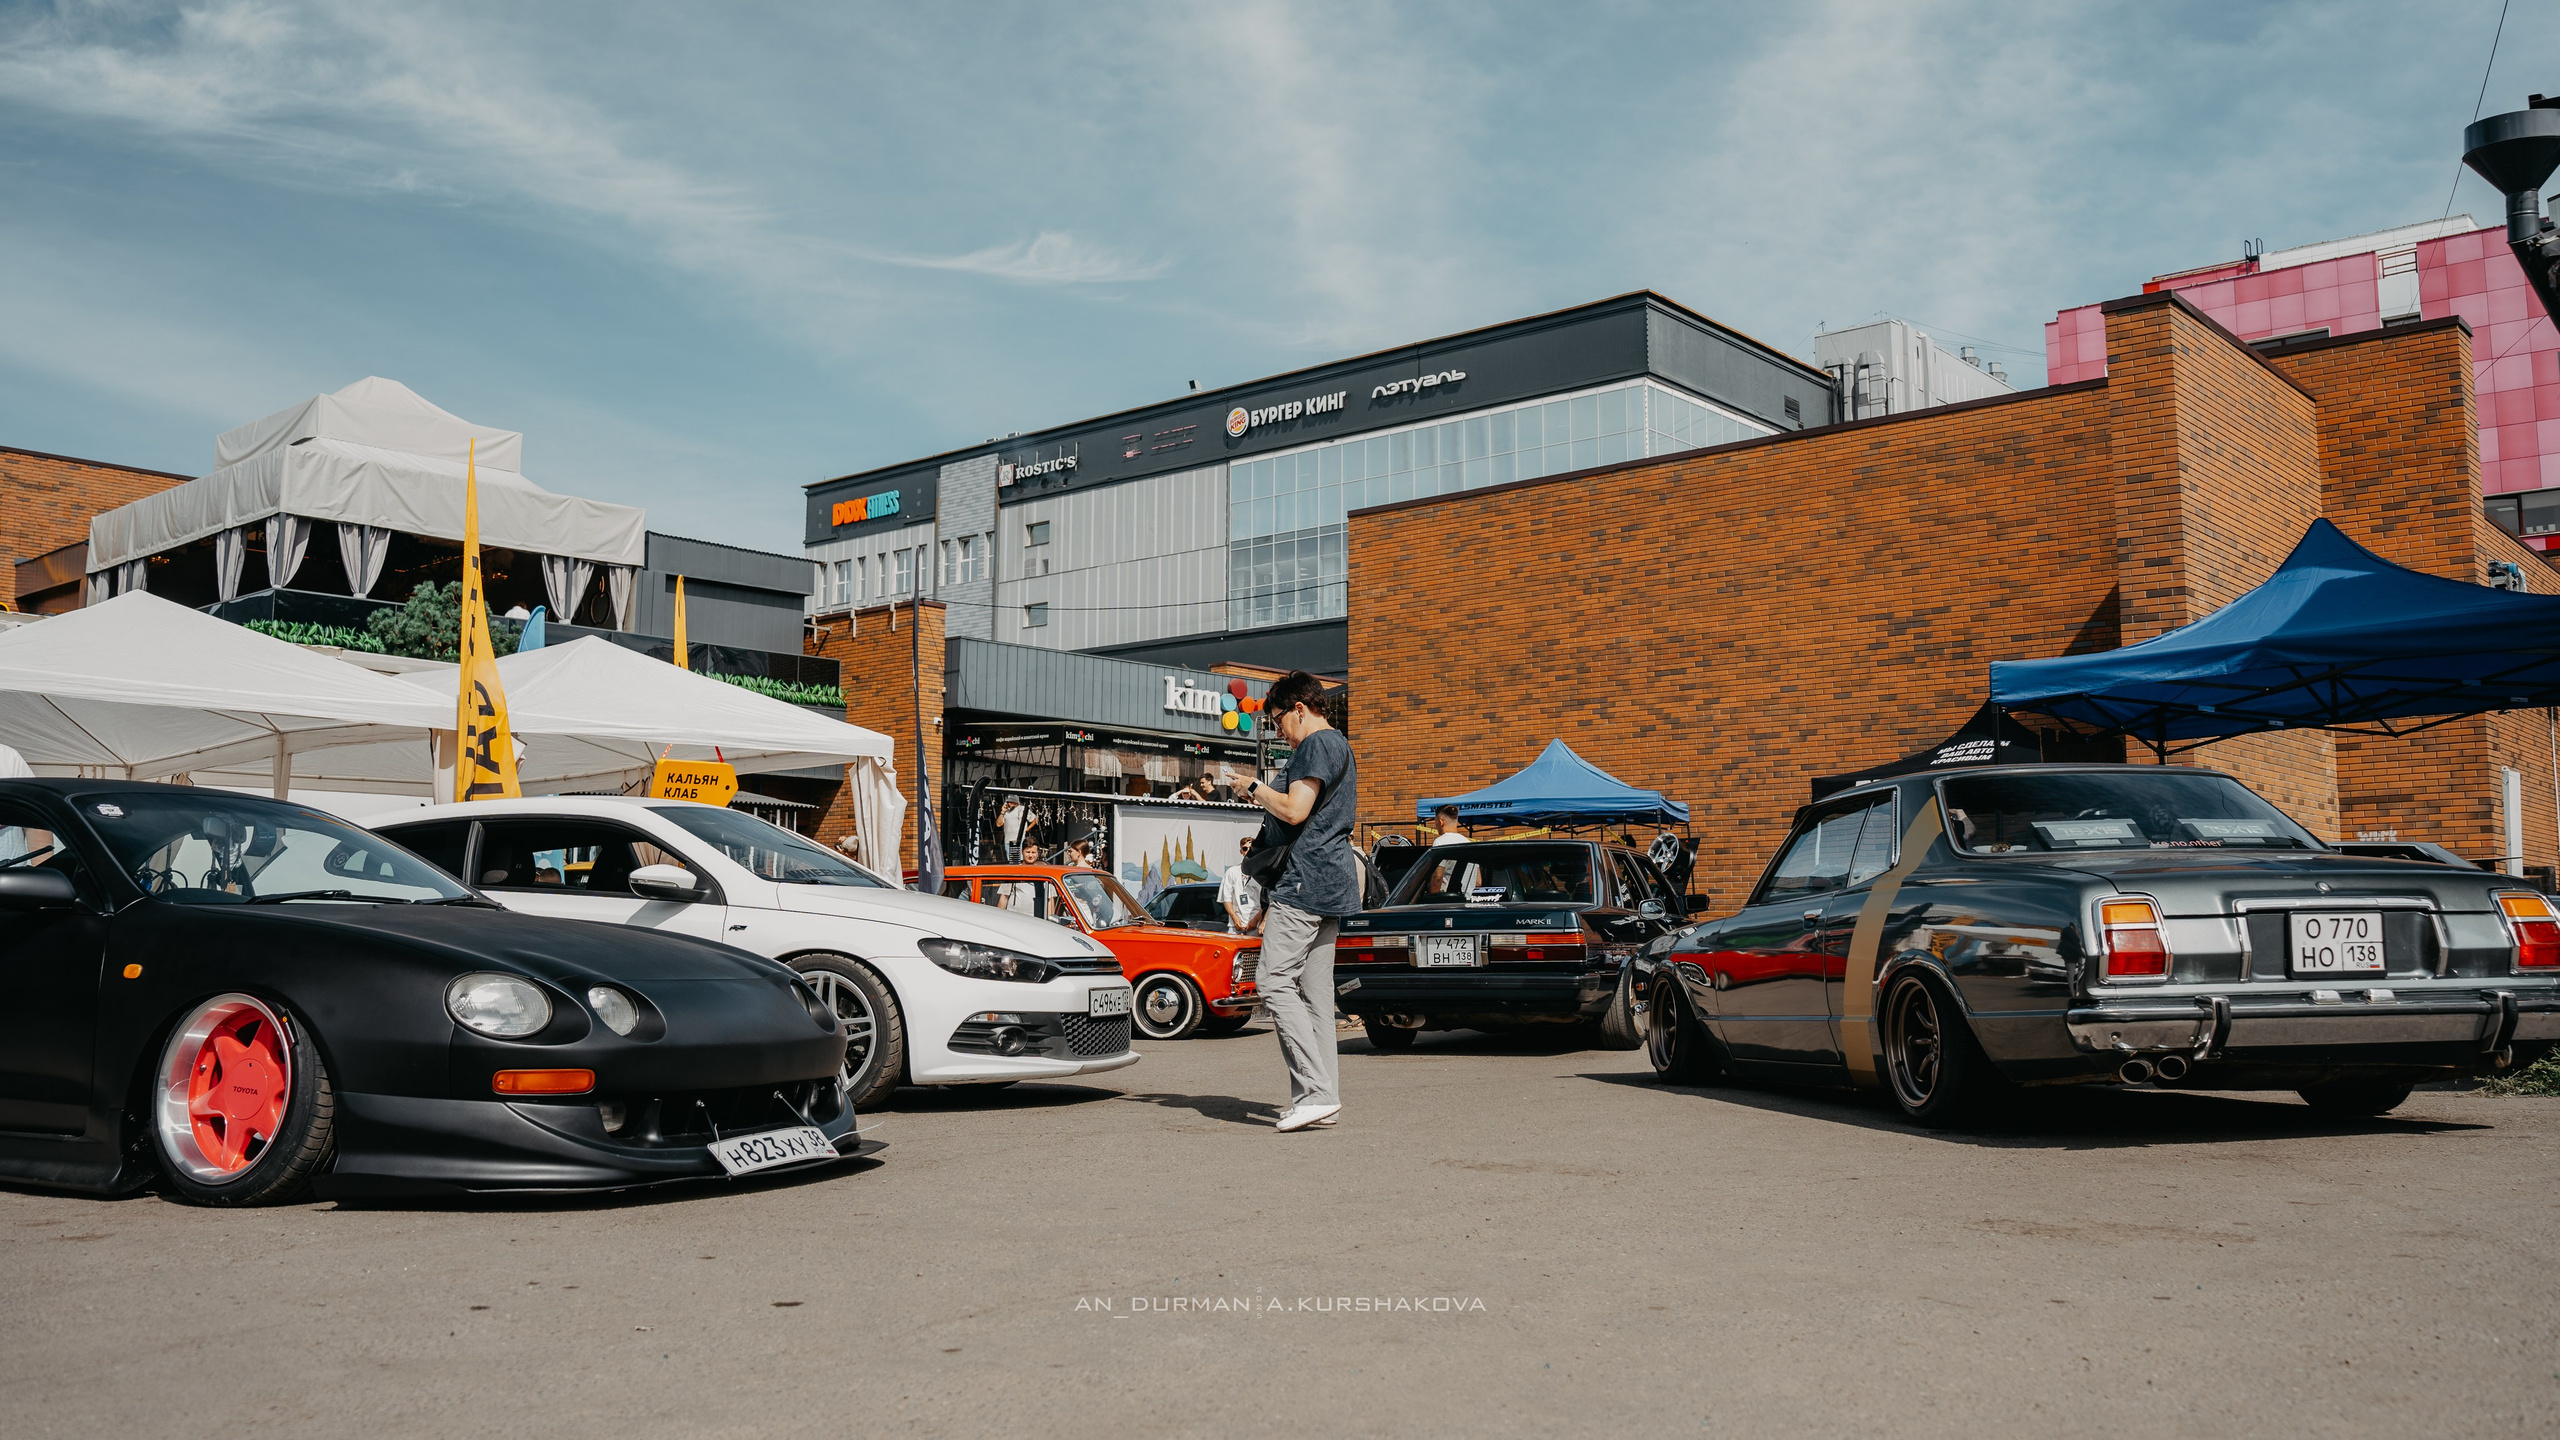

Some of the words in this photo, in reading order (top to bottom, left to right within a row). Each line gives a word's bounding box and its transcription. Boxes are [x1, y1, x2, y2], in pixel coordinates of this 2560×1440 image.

[1250, 400, 1303, 427] БУРГЕР
[1306, 390, 1347, 416] КИНГ
[1015, 455, 1077, 480] ROSTIC'S
[1937, 745, 1958, 755] МЫ
[1956, 739, 2012, 751] СДЕЛАМ
[1939, 749, 1967, 759] ВАШ
[1965, 747, 1996, 756] АВТО
[1929, 754, 1994, 765] КРАСИВЫМ
[666, 772, 720, 786] КАЛЬЯН
[663, 786, 699, 799] КЛАБ
[1430, 801, 1514, 813] WLSMASTER
[2329, 917, 2368, 939] 770
[1446, 938, 1467, 950] 472
[1433, 952, 1450, 964] ВН
[1455, 952, 1473, 961] 138
[2301, 946, 2335, 968] НО
[2346, 945, 2377, 962] 138
[2355, 961, 2370, 969] RUS
[233, 1085, 259, 1096] TOYOTA
[802, 1130, 826, 1147] 38
